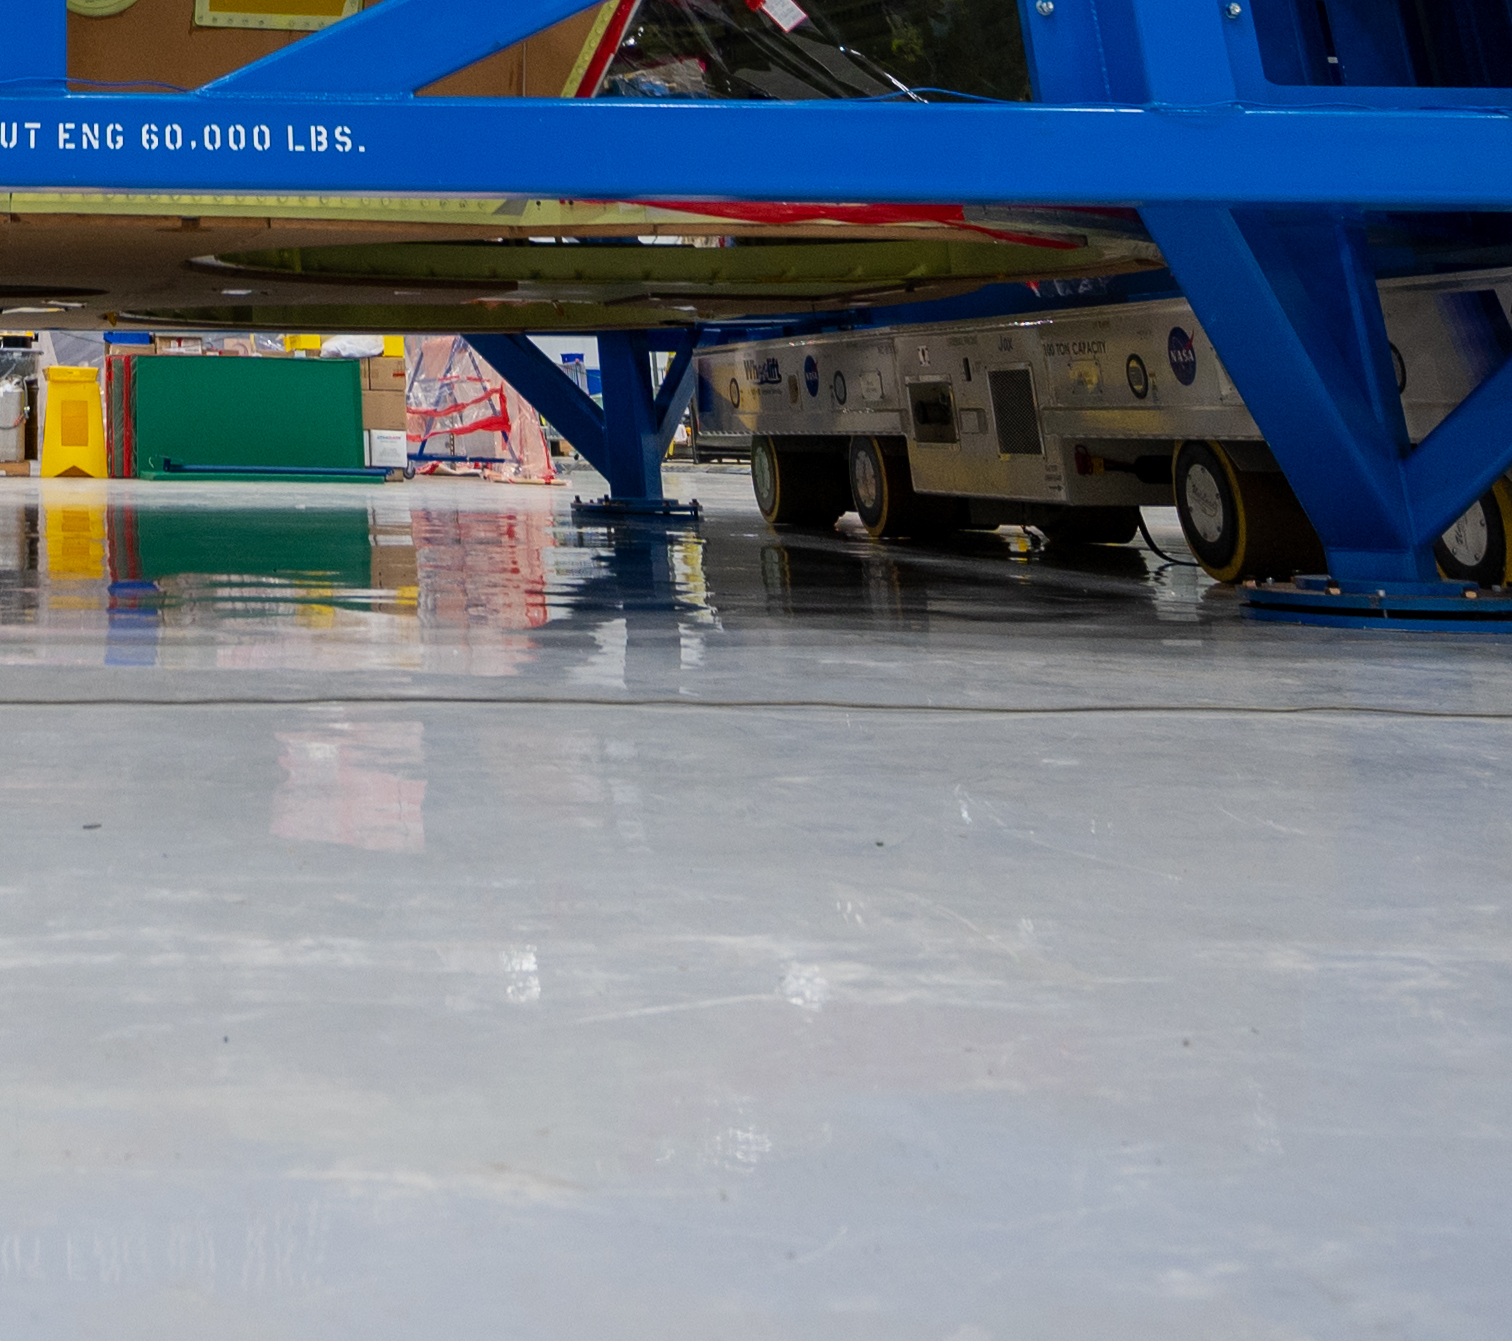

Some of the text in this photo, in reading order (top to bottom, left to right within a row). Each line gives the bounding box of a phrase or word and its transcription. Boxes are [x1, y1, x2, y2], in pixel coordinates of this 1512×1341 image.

[58, 122, 124, 150] ENG
[287, 125, 365, 153] LBS.
[1072, 340, 1107, 355] CAPACITY
